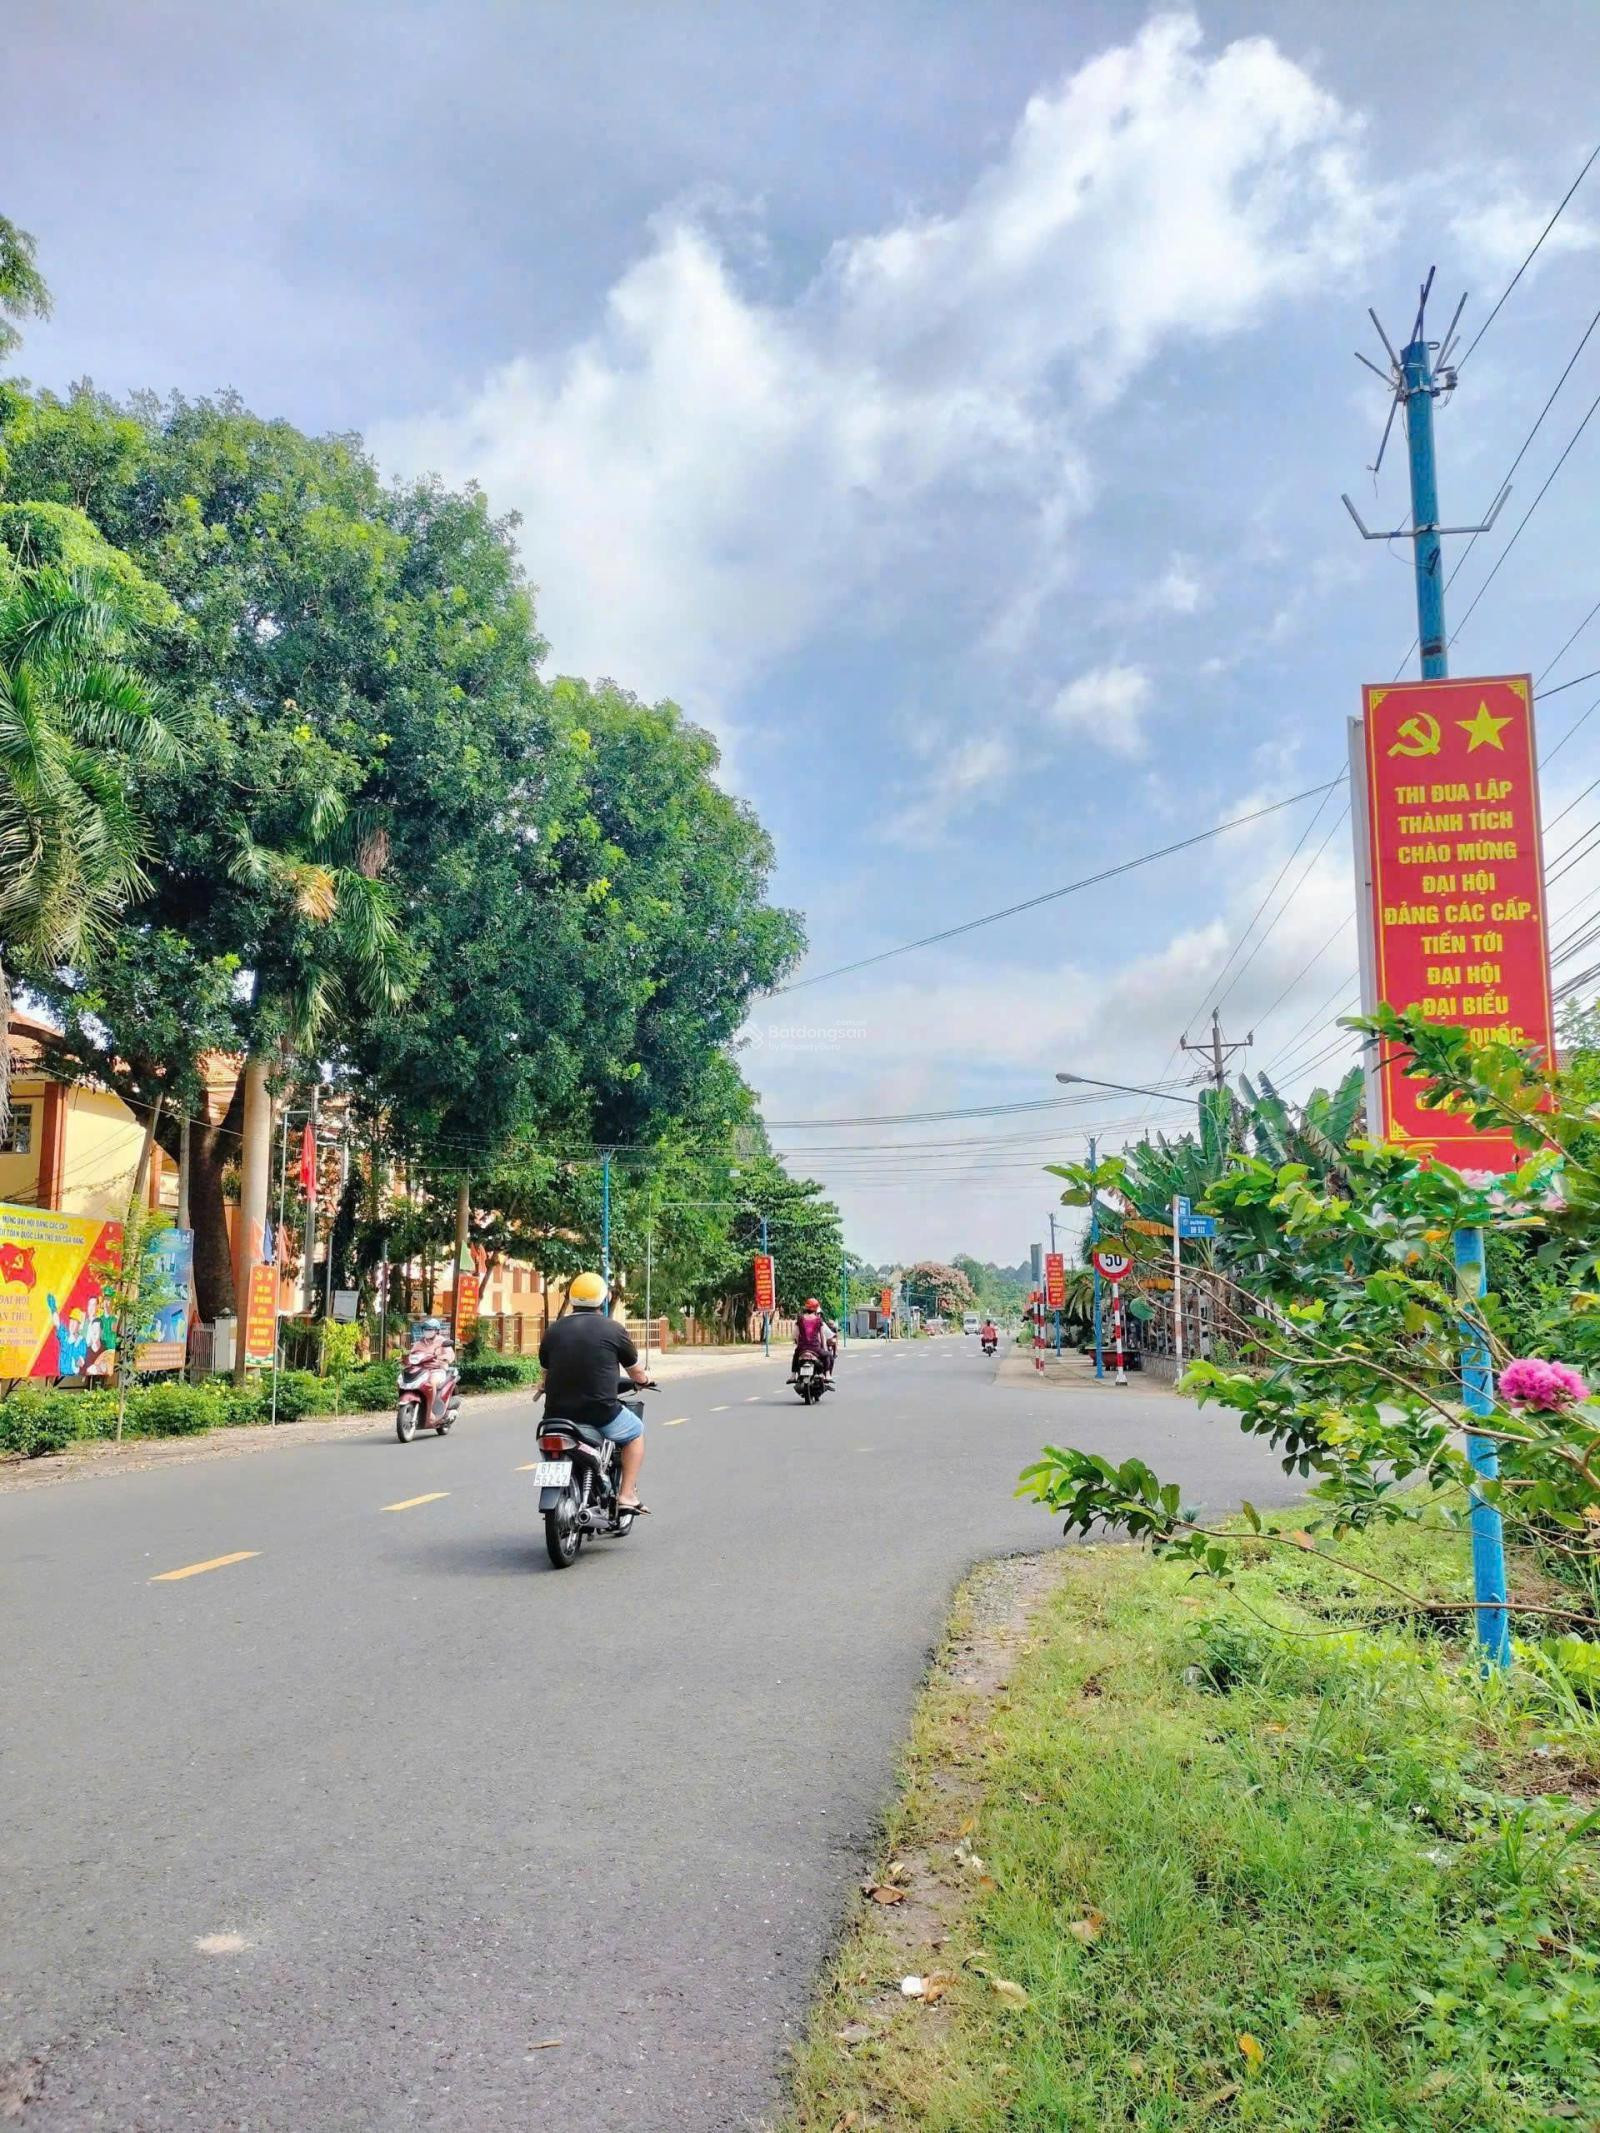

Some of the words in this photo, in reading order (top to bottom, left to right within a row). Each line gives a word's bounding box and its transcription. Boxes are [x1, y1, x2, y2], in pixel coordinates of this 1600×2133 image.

[1395, 786, 1425, 804] THI
[1431, 783, 1470, 803] ĐUA
[1476, 778, 1513, 804] LẬP
[1398, 812, 1463, 834] THÀNH
[1469, 808, 1513, 830] TÍCH
[1398, 843, 1451, 864] CHÀO
[1456, 838, 1517, 861] MỪNG
[1422, 874, 1456, 896] ĐẠI
[1462, 869, 1495, 892] HỘI
[1384, 901, 1440, 926] ĐẢNG
[1445, 899, 1485, 922] CÁC
[1421, 931, 1465, 954] TIẾN
[1471, 930, 1503, 952] TỚI
[1427, 966, 1461, 989] ĐẠI
[1467, 961, 1500, 987] HỘI
[1422, 997, 1457, 1020] ĐẠI
[1463, 989, 1509, 1015] BIỂU
[1106, 1254, 1122, 1267] 50
